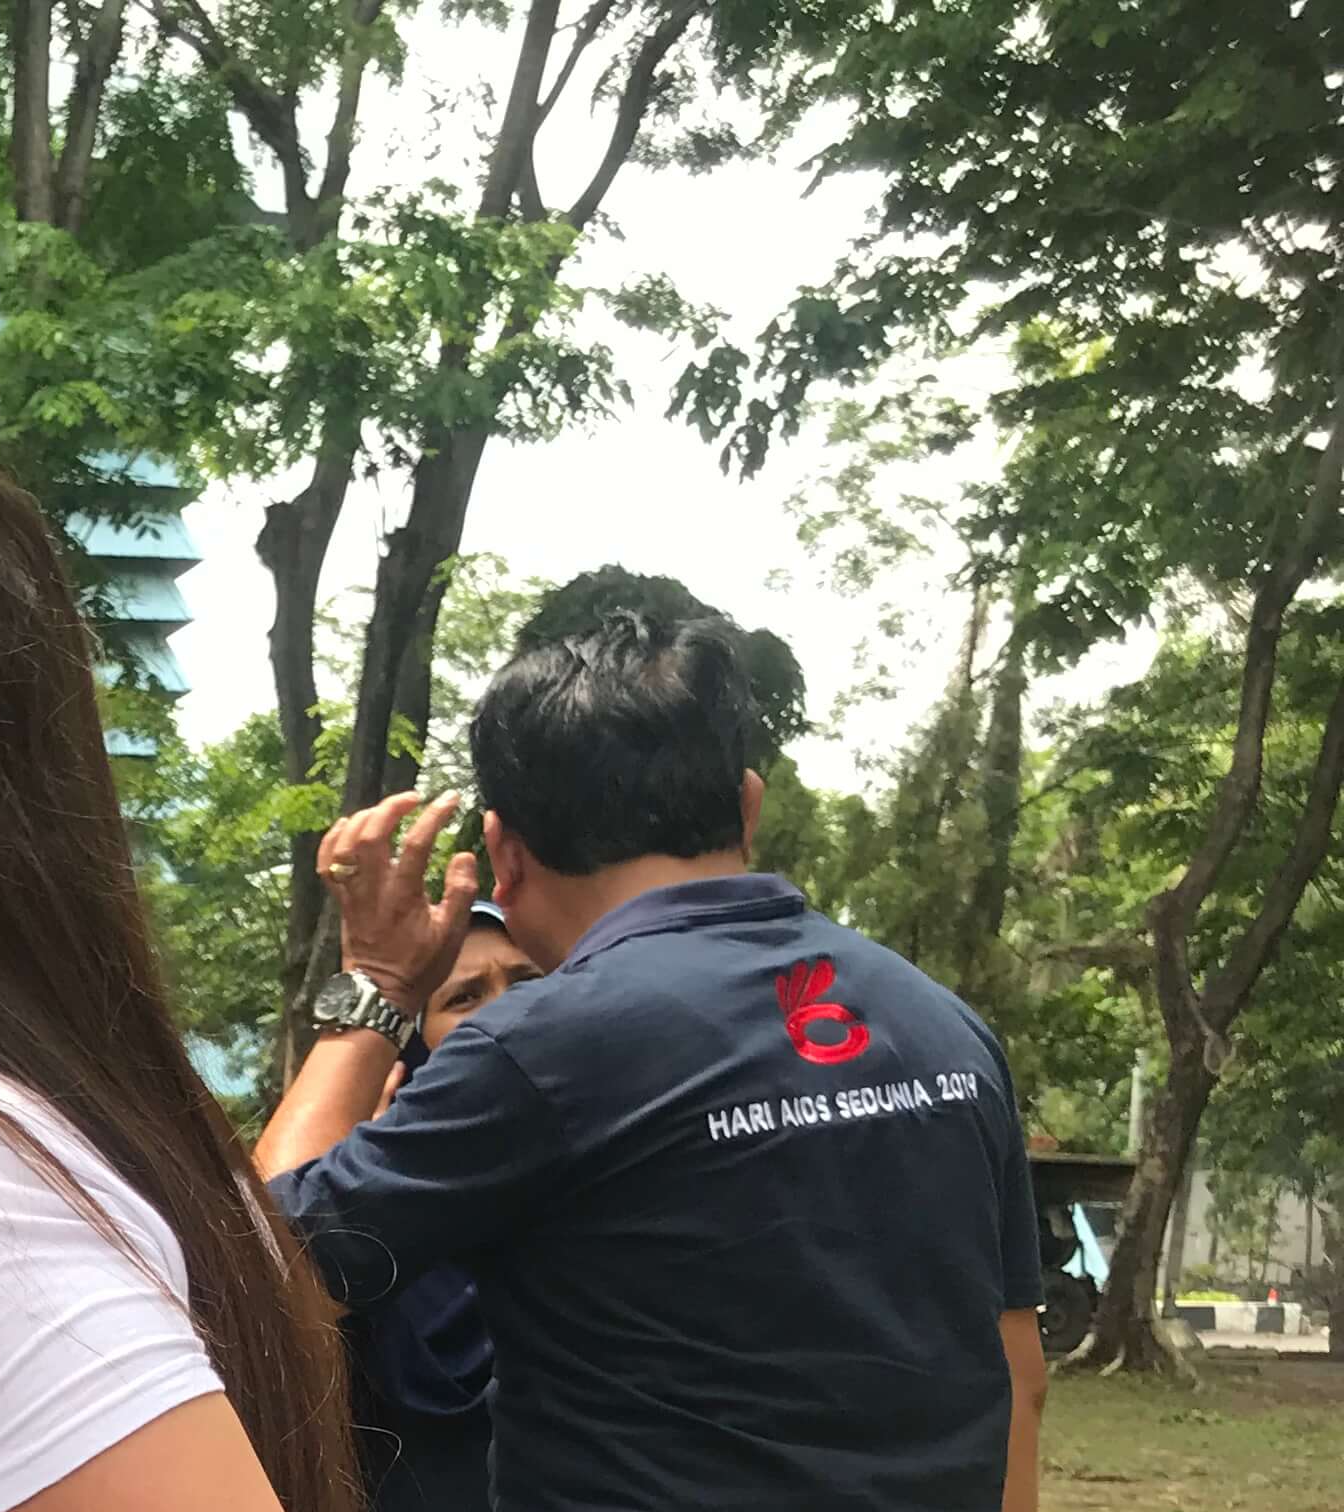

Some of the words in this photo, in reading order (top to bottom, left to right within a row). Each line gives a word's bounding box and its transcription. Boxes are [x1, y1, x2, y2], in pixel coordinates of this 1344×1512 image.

[707, 1103, 776, 1141] HARI
[781, 1094, 831, 1128] AIDS
[835, 1079, 934, 1119] SEDUNIA
[936, 1072, 978, 1101] 2019
